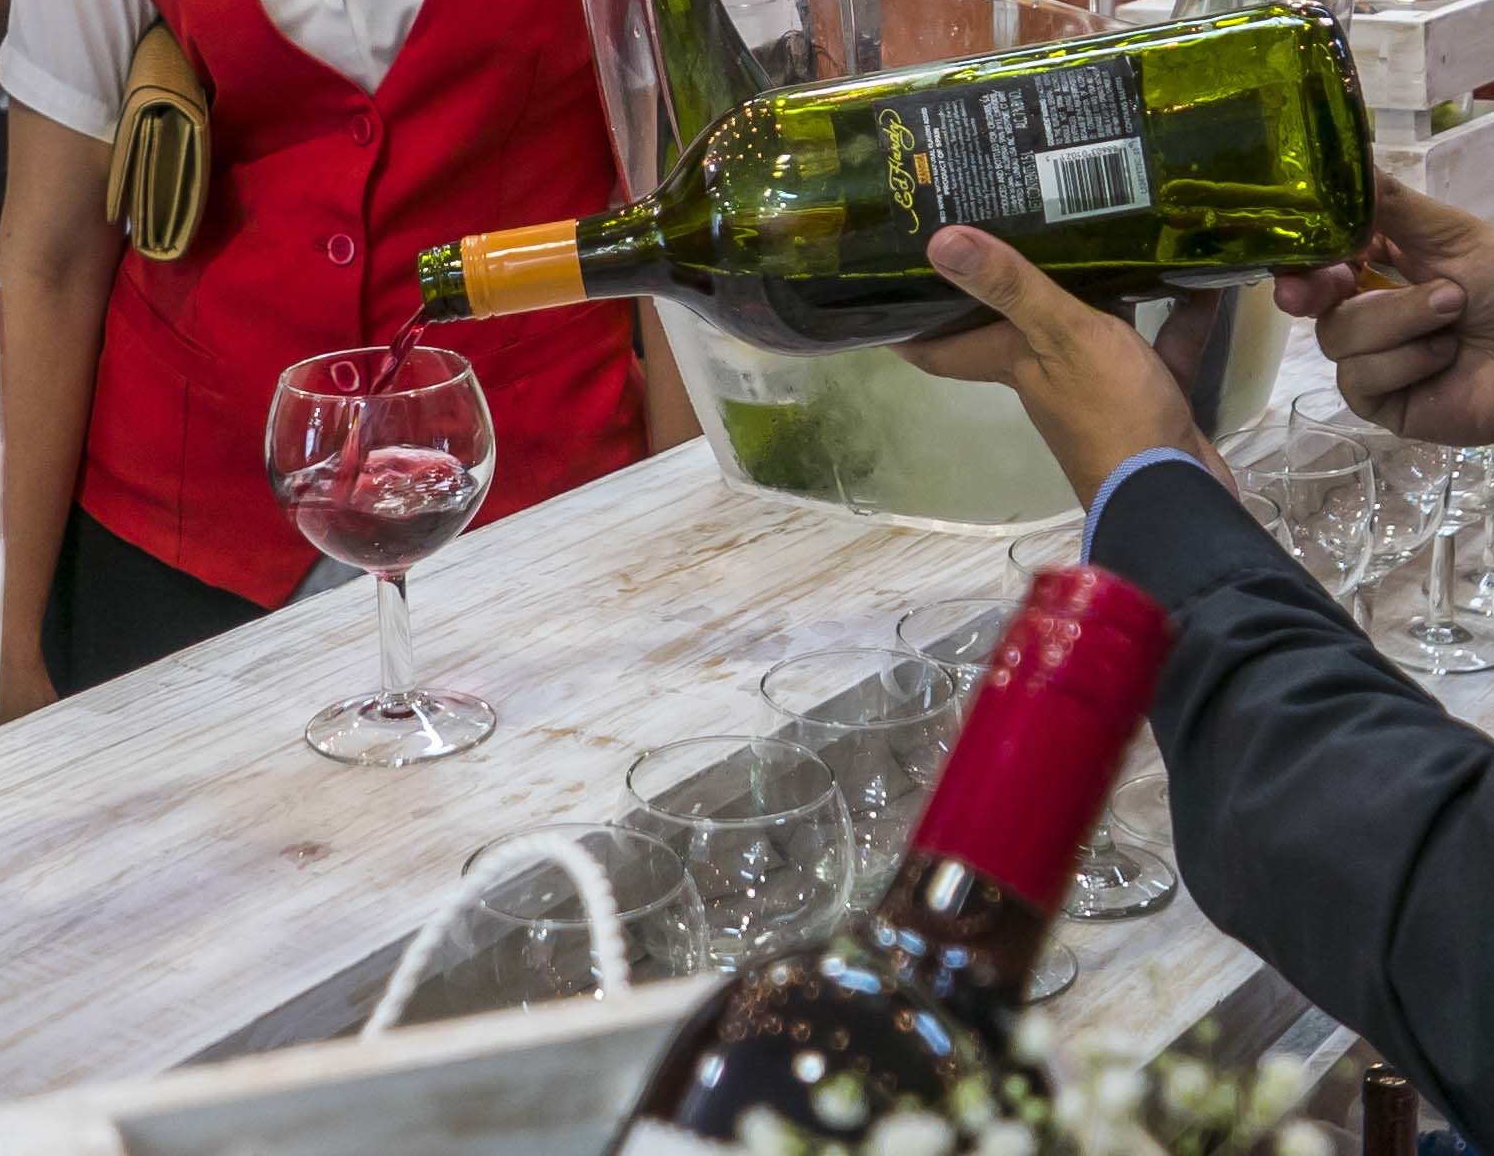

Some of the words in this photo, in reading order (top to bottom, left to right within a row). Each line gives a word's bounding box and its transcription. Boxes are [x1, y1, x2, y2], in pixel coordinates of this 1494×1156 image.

[878, 107, 916, 190] Hardy
[932, 127, 942, 147] SPAIN
[936, 148, 944, 157] OF
[938, 159, 950, 195] PRODUCT
